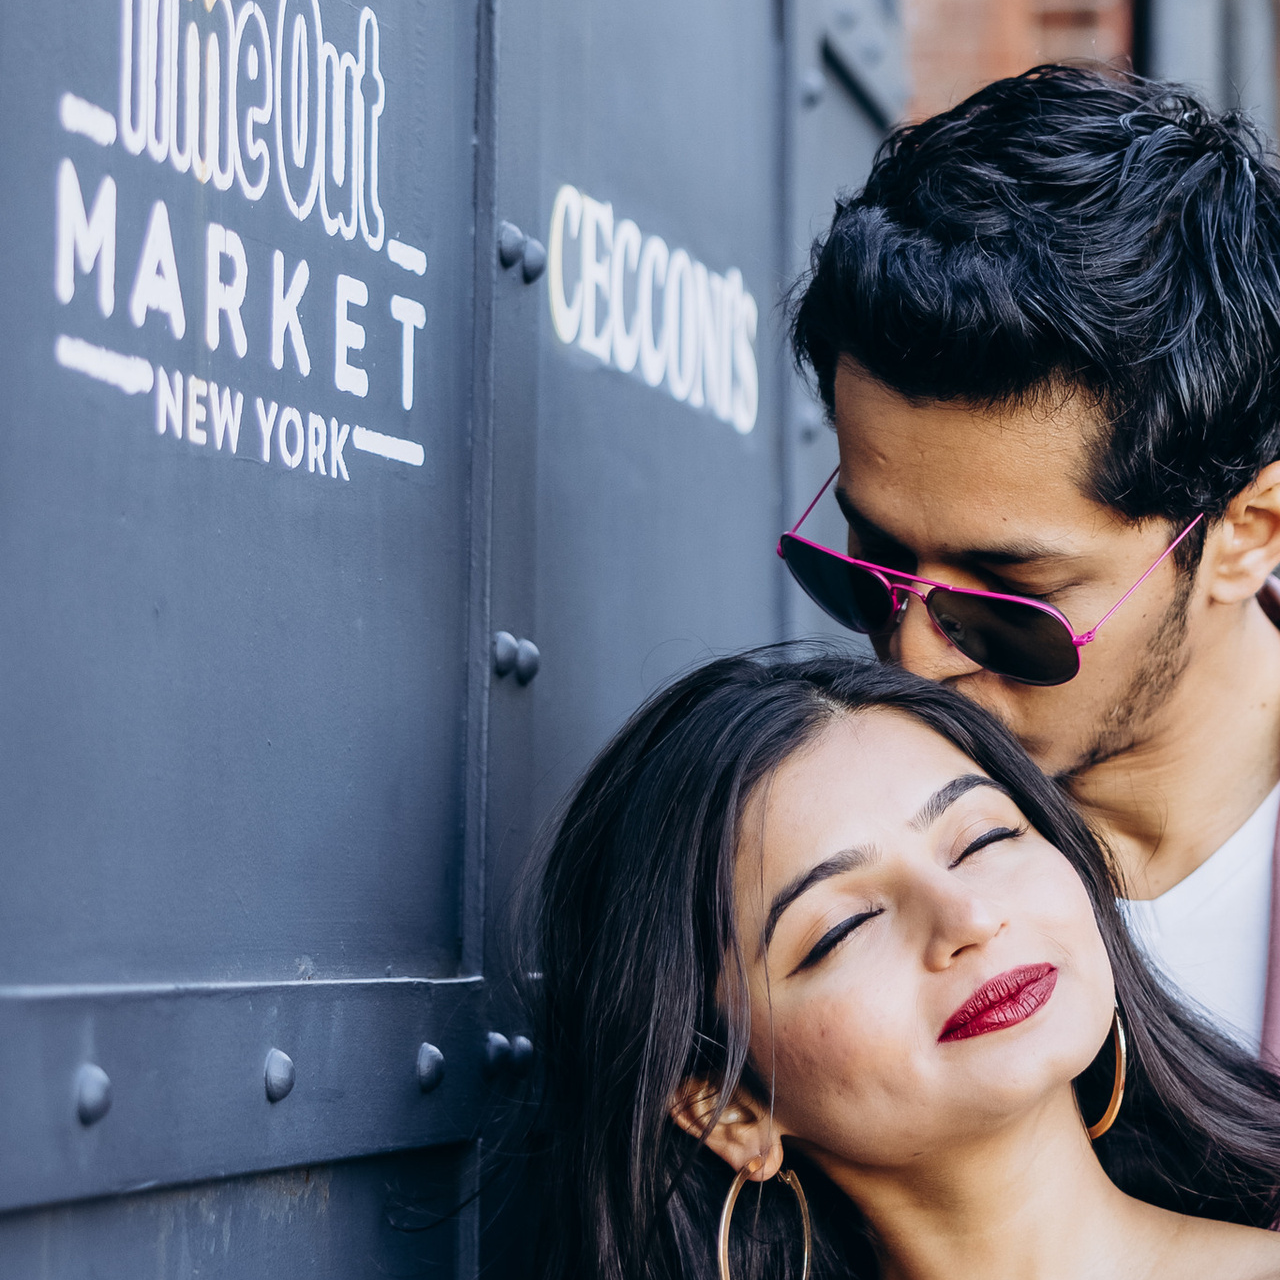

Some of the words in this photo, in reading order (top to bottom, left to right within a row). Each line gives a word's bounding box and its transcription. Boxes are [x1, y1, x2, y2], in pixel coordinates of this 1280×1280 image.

[56, 157, 427, 411] MARKET
[154, 365, 244, 454] NEW
[256, 396, 350, 481] YORK
